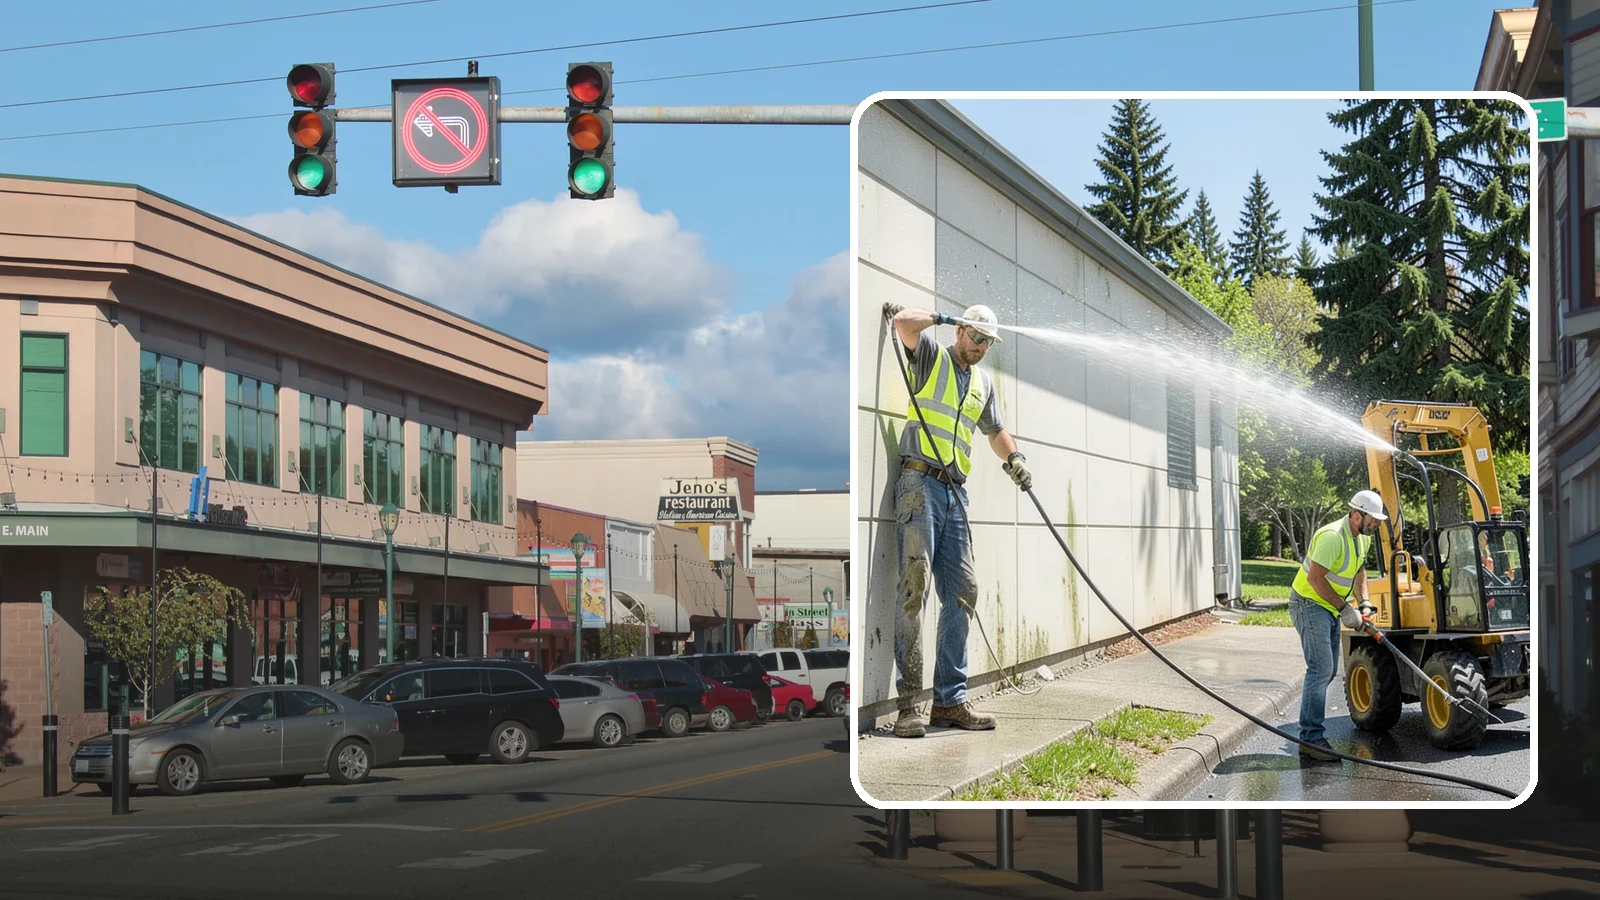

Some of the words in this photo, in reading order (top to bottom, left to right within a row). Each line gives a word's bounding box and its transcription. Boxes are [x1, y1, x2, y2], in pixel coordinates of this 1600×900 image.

[670, 480, 727, 494] Jeno's
[665, 496, 731, 509] restaurant
[658, 509, 681, 519] Italian
[686, 510, 714, 519] American
[715, 509, 738, 519] Cuisine
[2, 525, 13, 536] E.
[15, 525, 49, 536] MAIN
[797, 608, 828, 616] Street
[788, 619, 823, 627] lass
